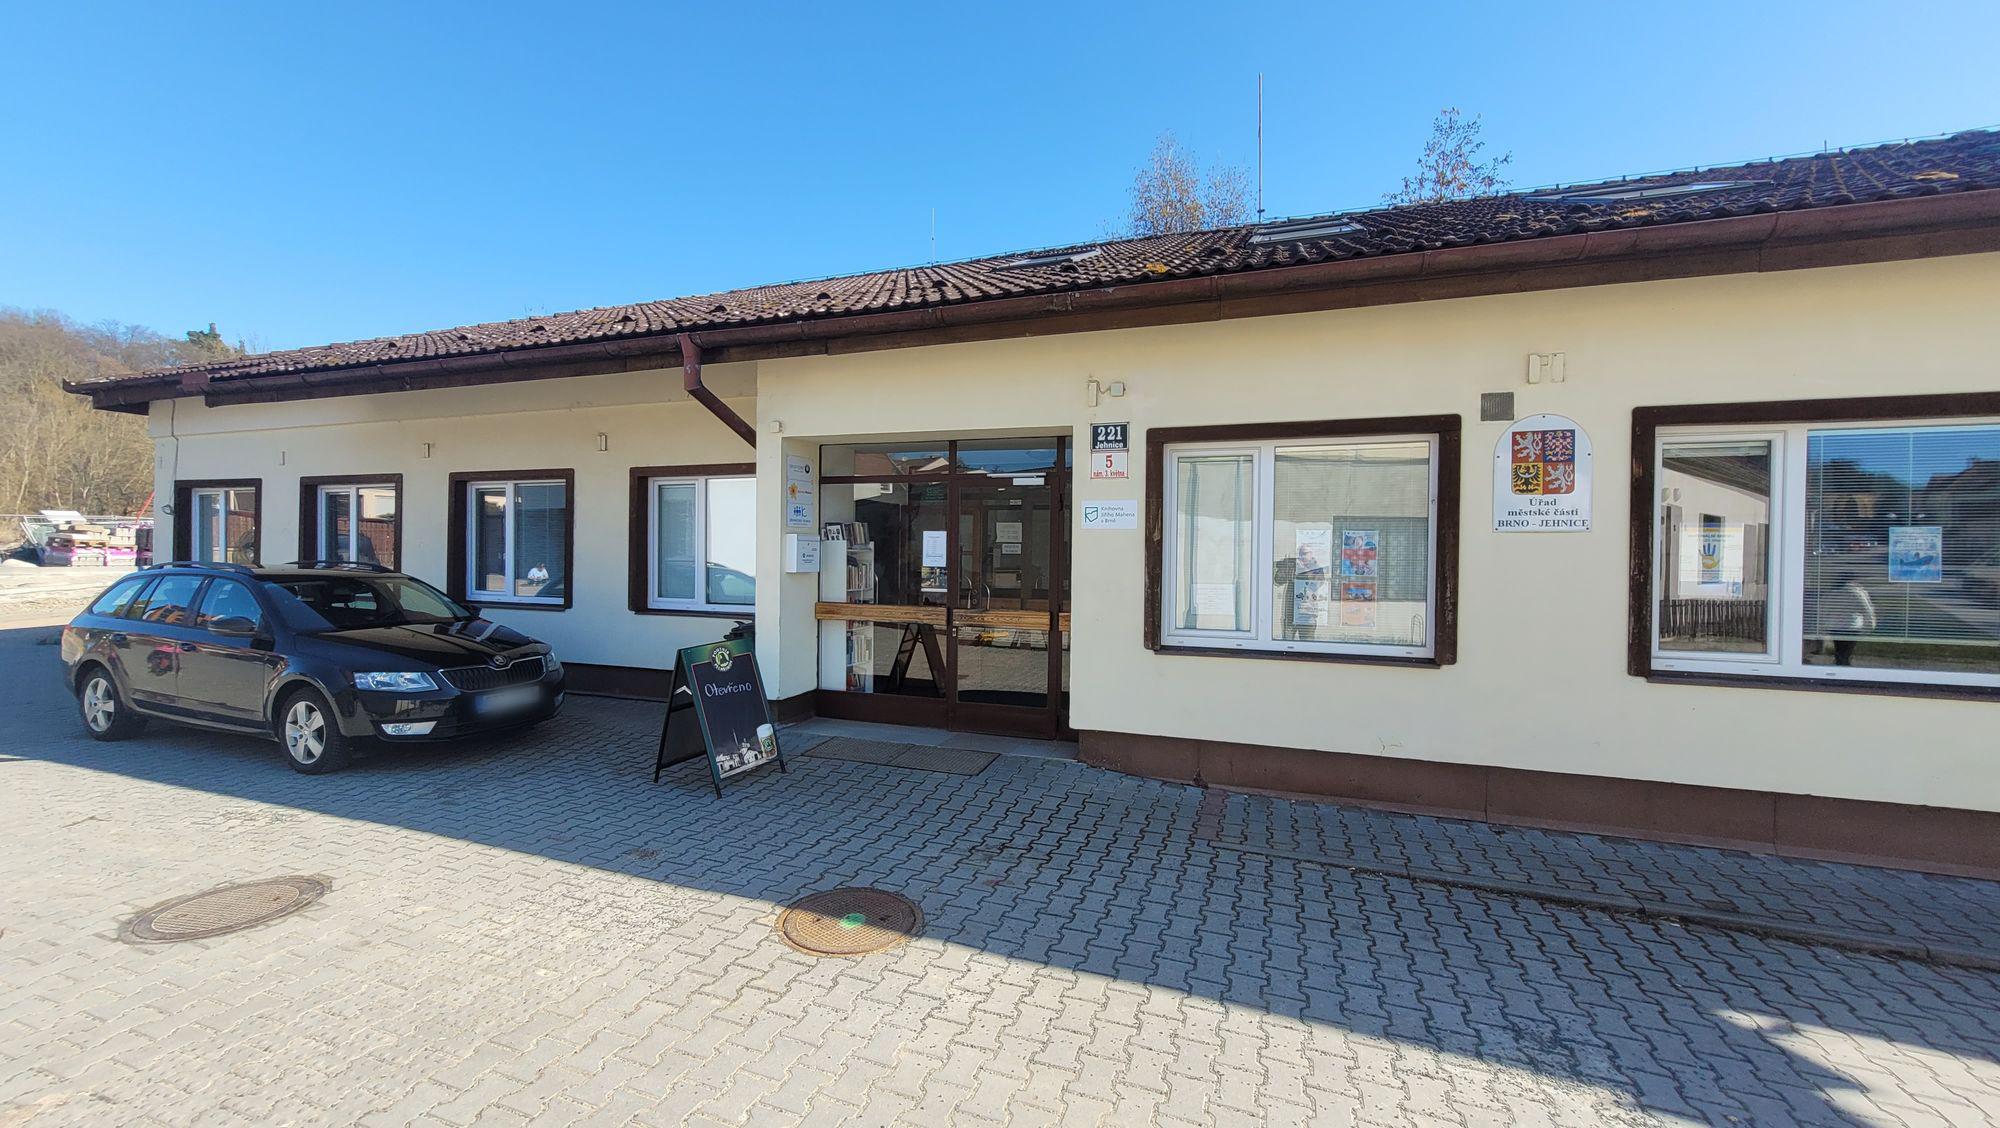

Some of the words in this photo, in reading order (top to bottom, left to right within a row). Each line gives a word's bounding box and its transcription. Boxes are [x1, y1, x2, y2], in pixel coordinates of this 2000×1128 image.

[1097, 426, 1122, 441] 221
[1095, 441, 1124, 449] Jehnice
[1105, 454, 1113, 469] 5
[1529, 497, 1557, 507] Úřad
[1507, 508, 1550, 517] městské
[1553, 508, 1579, 516] části
[1497, 519, 1529, 528] BRNO
[1538, 519, 1588, 528] JEHNICE
[704, 682, 752, 698] Otevřeno
